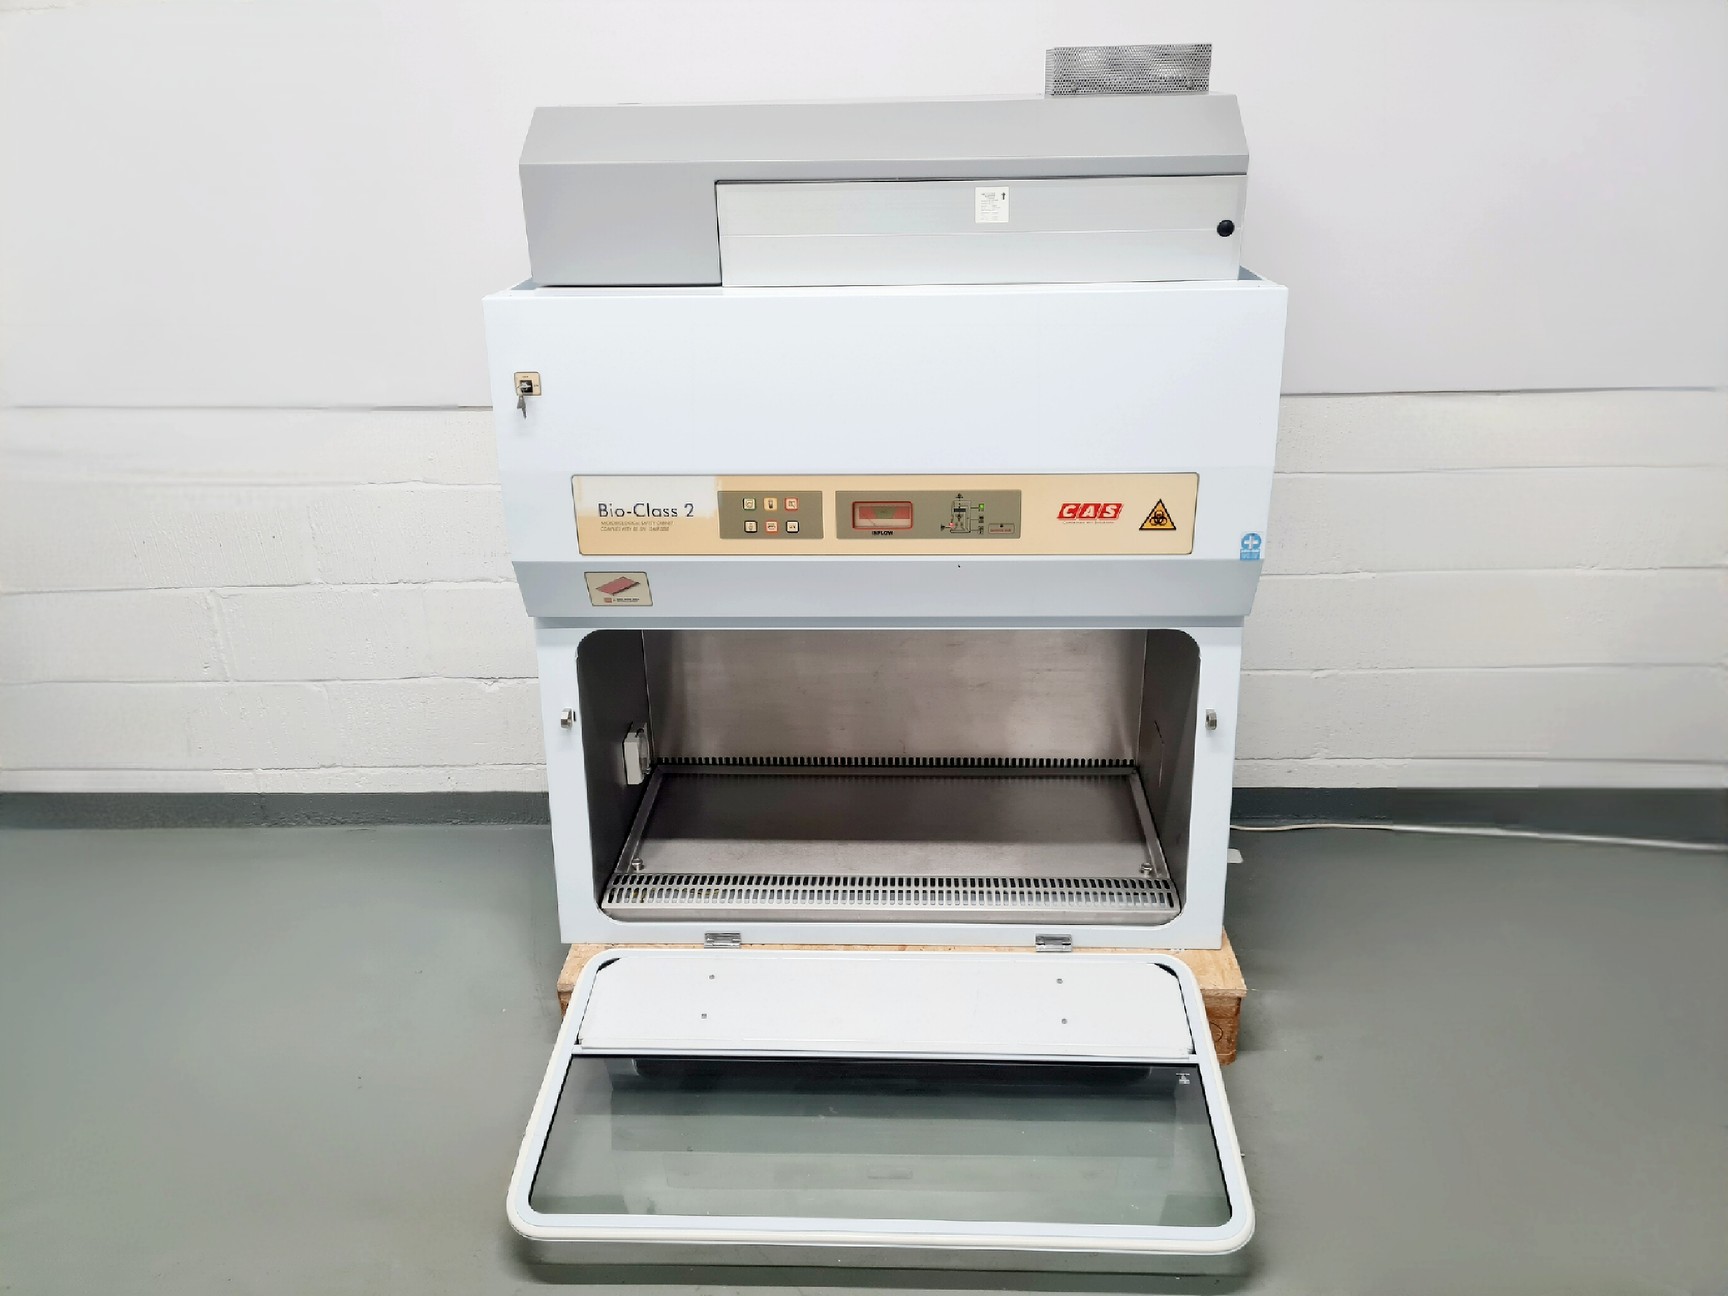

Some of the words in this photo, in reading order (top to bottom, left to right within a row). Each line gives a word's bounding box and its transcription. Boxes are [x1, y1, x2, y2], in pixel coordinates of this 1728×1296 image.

[598, 502, 678, 518] Bio-Class
[684, 502, 694, 518] 2
[1060, 503, 1120, 519] CAS
